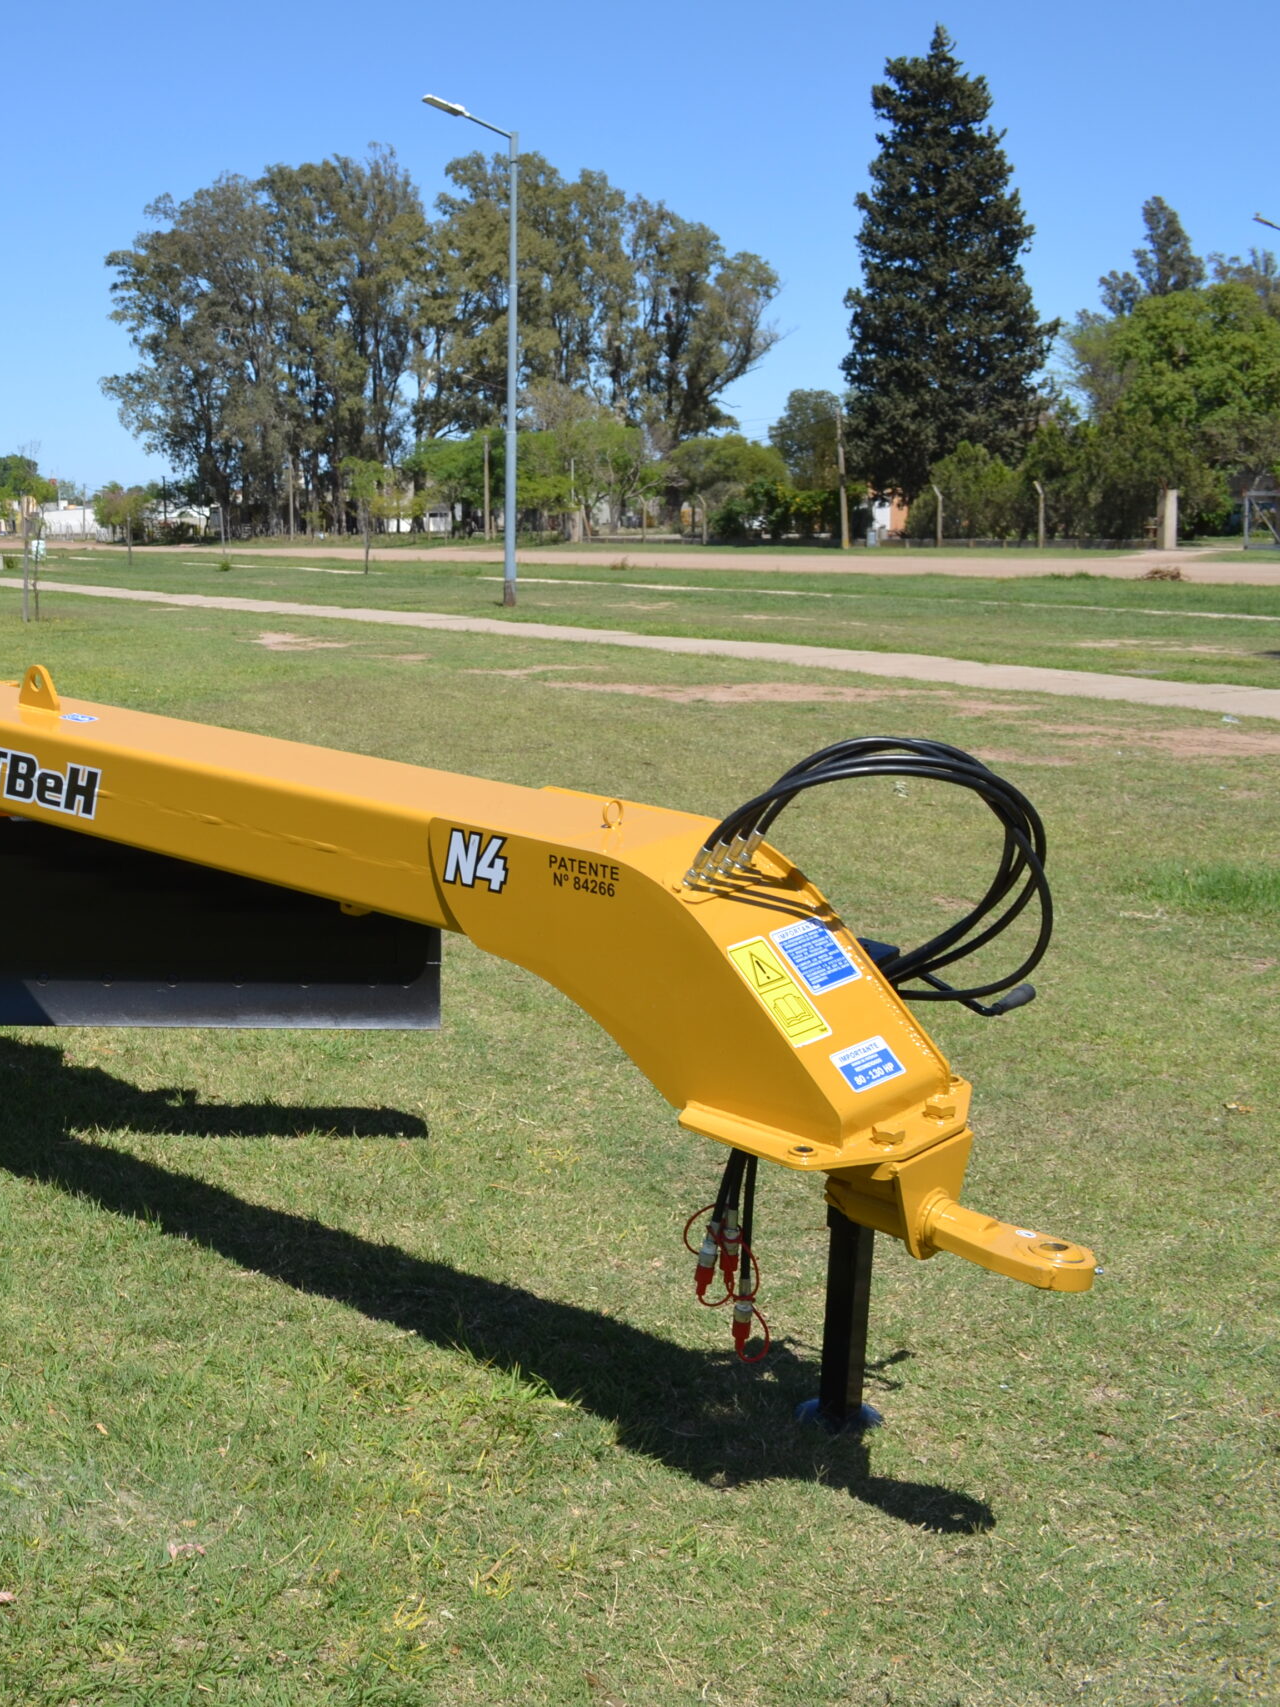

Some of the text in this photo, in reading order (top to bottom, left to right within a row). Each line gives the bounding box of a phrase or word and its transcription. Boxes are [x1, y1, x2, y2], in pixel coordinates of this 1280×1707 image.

[443, 827, 509, 895] N4
[548, 854, 620, 881] PATENTE
[573, 876, 615, 898] 84266
[839, 1042, 880, 1063] IMPORTANTE
[882, 1061, 895, 1074] HP
